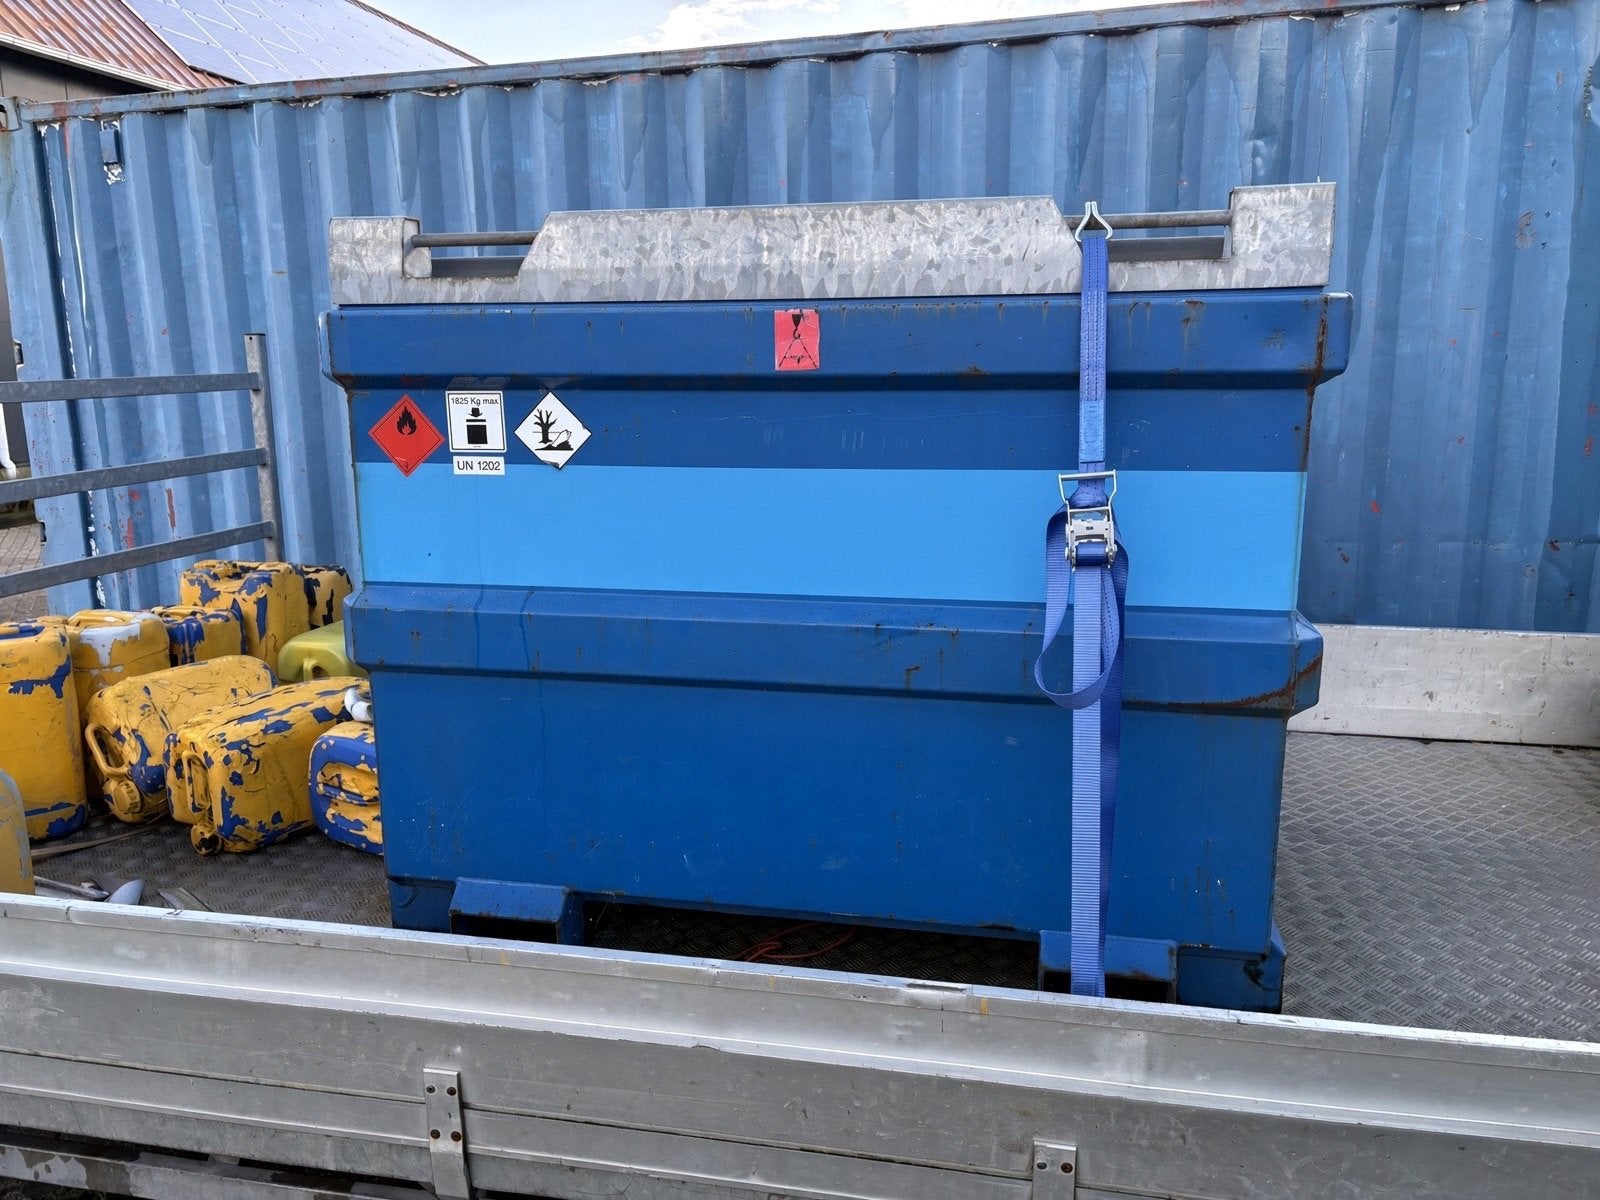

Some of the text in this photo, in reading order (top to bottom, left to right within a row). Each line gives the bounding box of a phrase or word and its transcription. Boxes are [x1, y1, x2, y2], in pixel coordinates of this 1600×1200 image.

[451, 397, 469, 405] 1825
[470, 397, 481, 407] Kg
[457, 460, 501, 471] UN 1202
